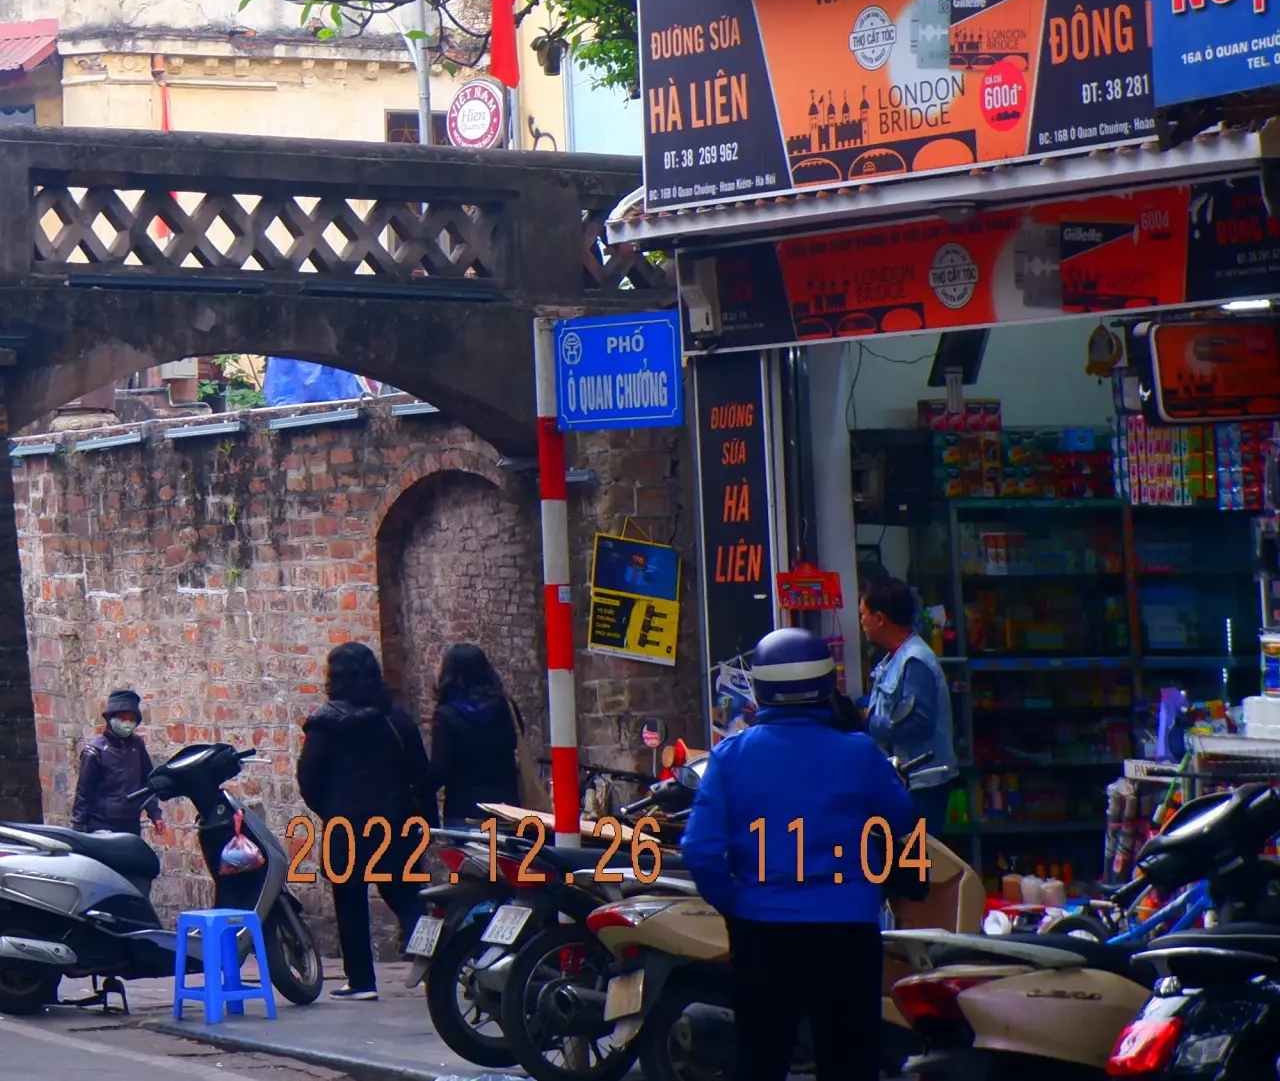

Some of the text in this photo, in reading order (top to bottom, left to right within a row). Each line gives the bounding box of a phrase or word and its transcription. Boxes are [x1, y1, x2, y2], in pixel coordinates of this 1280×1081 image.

[651, 15, 742, 61] ĐƯỜNG SỮA
[987, 29, 1027, 41] LONDON
[987, 39, 1020, 51] BRIDGE
[1049, 3, 1134, 66] ĐÔNG
[1181, 52, 1203, 65] 16A
[1216, 41, 1249, 59] QUAN
[1247, 55, 1271, 70] TEL.
[473, 86, 497, 113] NAM
[648, 69, 749, 134] HÀ LIÊN
[877, 73, 966, 111] LONDON
[1082, 73, 1150, 105] ĐT: 38 281
[878, 100, 952, 136] BRIDGE
[1077, 125, 1097, 140] Quan
[664, 141, 739, 169] ĐT: 38 269 962
[677, 184, 694, 198] Quan
[1063, 227, 1104, 242] Gillette
[853, 264, 916, 288] LONDON
[855, 284, 907, 304] BRIDGE
[606, 326, 645, 354] PHỐ
[567, 357, 669, 415] Ô QUAN CHƯỞNG
[721, 437, 747, 465] SỮA
[723, 477, 751, 522] HÀ
[715, 538, 763, 583] LIÊN
